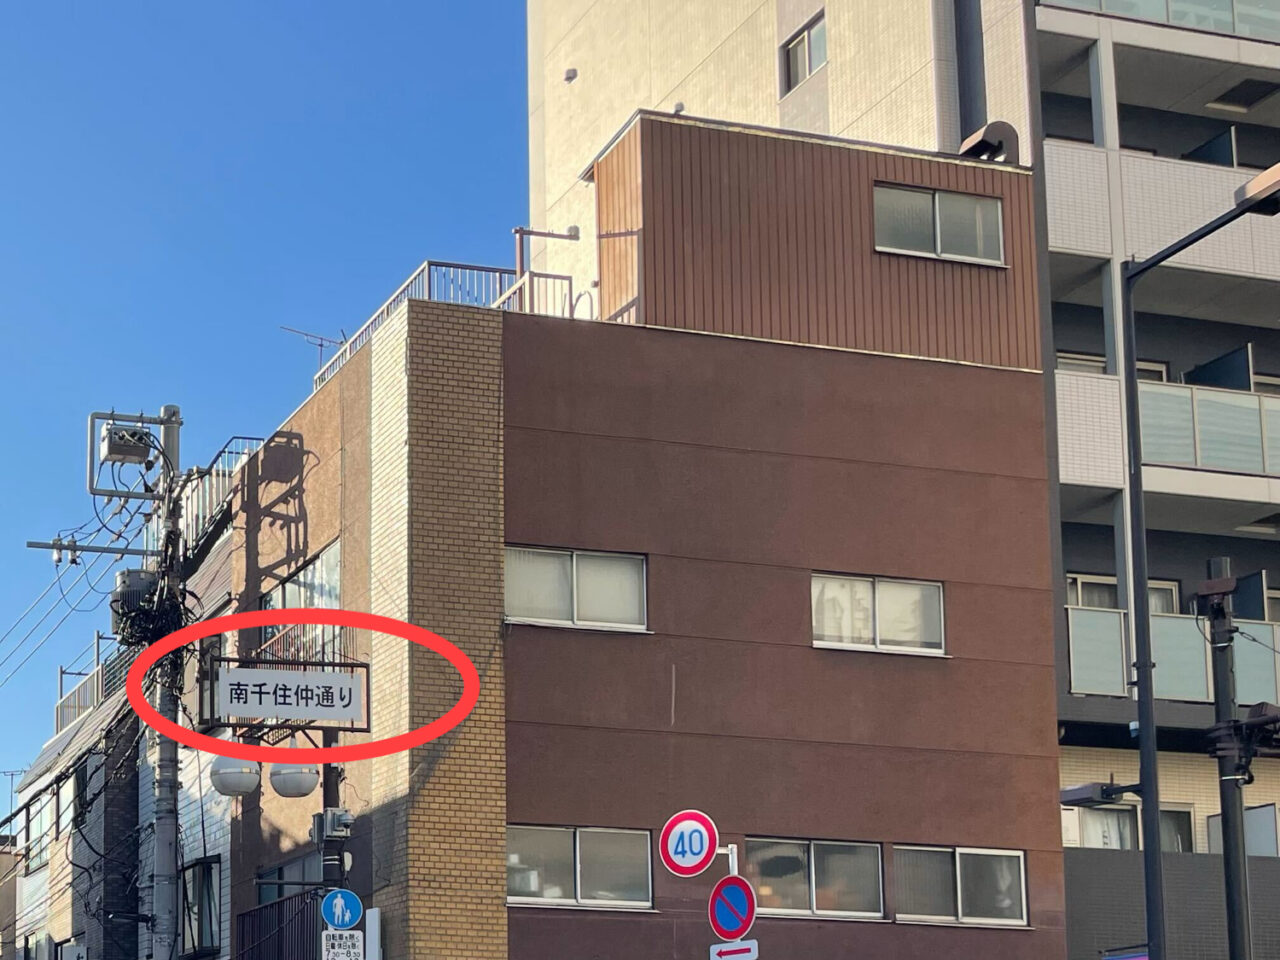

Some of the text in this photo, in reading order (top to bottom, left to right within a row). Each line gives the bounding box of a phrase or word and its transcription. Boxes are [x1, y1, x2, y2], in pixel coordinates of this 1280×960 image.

[228, 681, 353, 708] 南千住仲通り
[674, 829, 704, 858] 40
